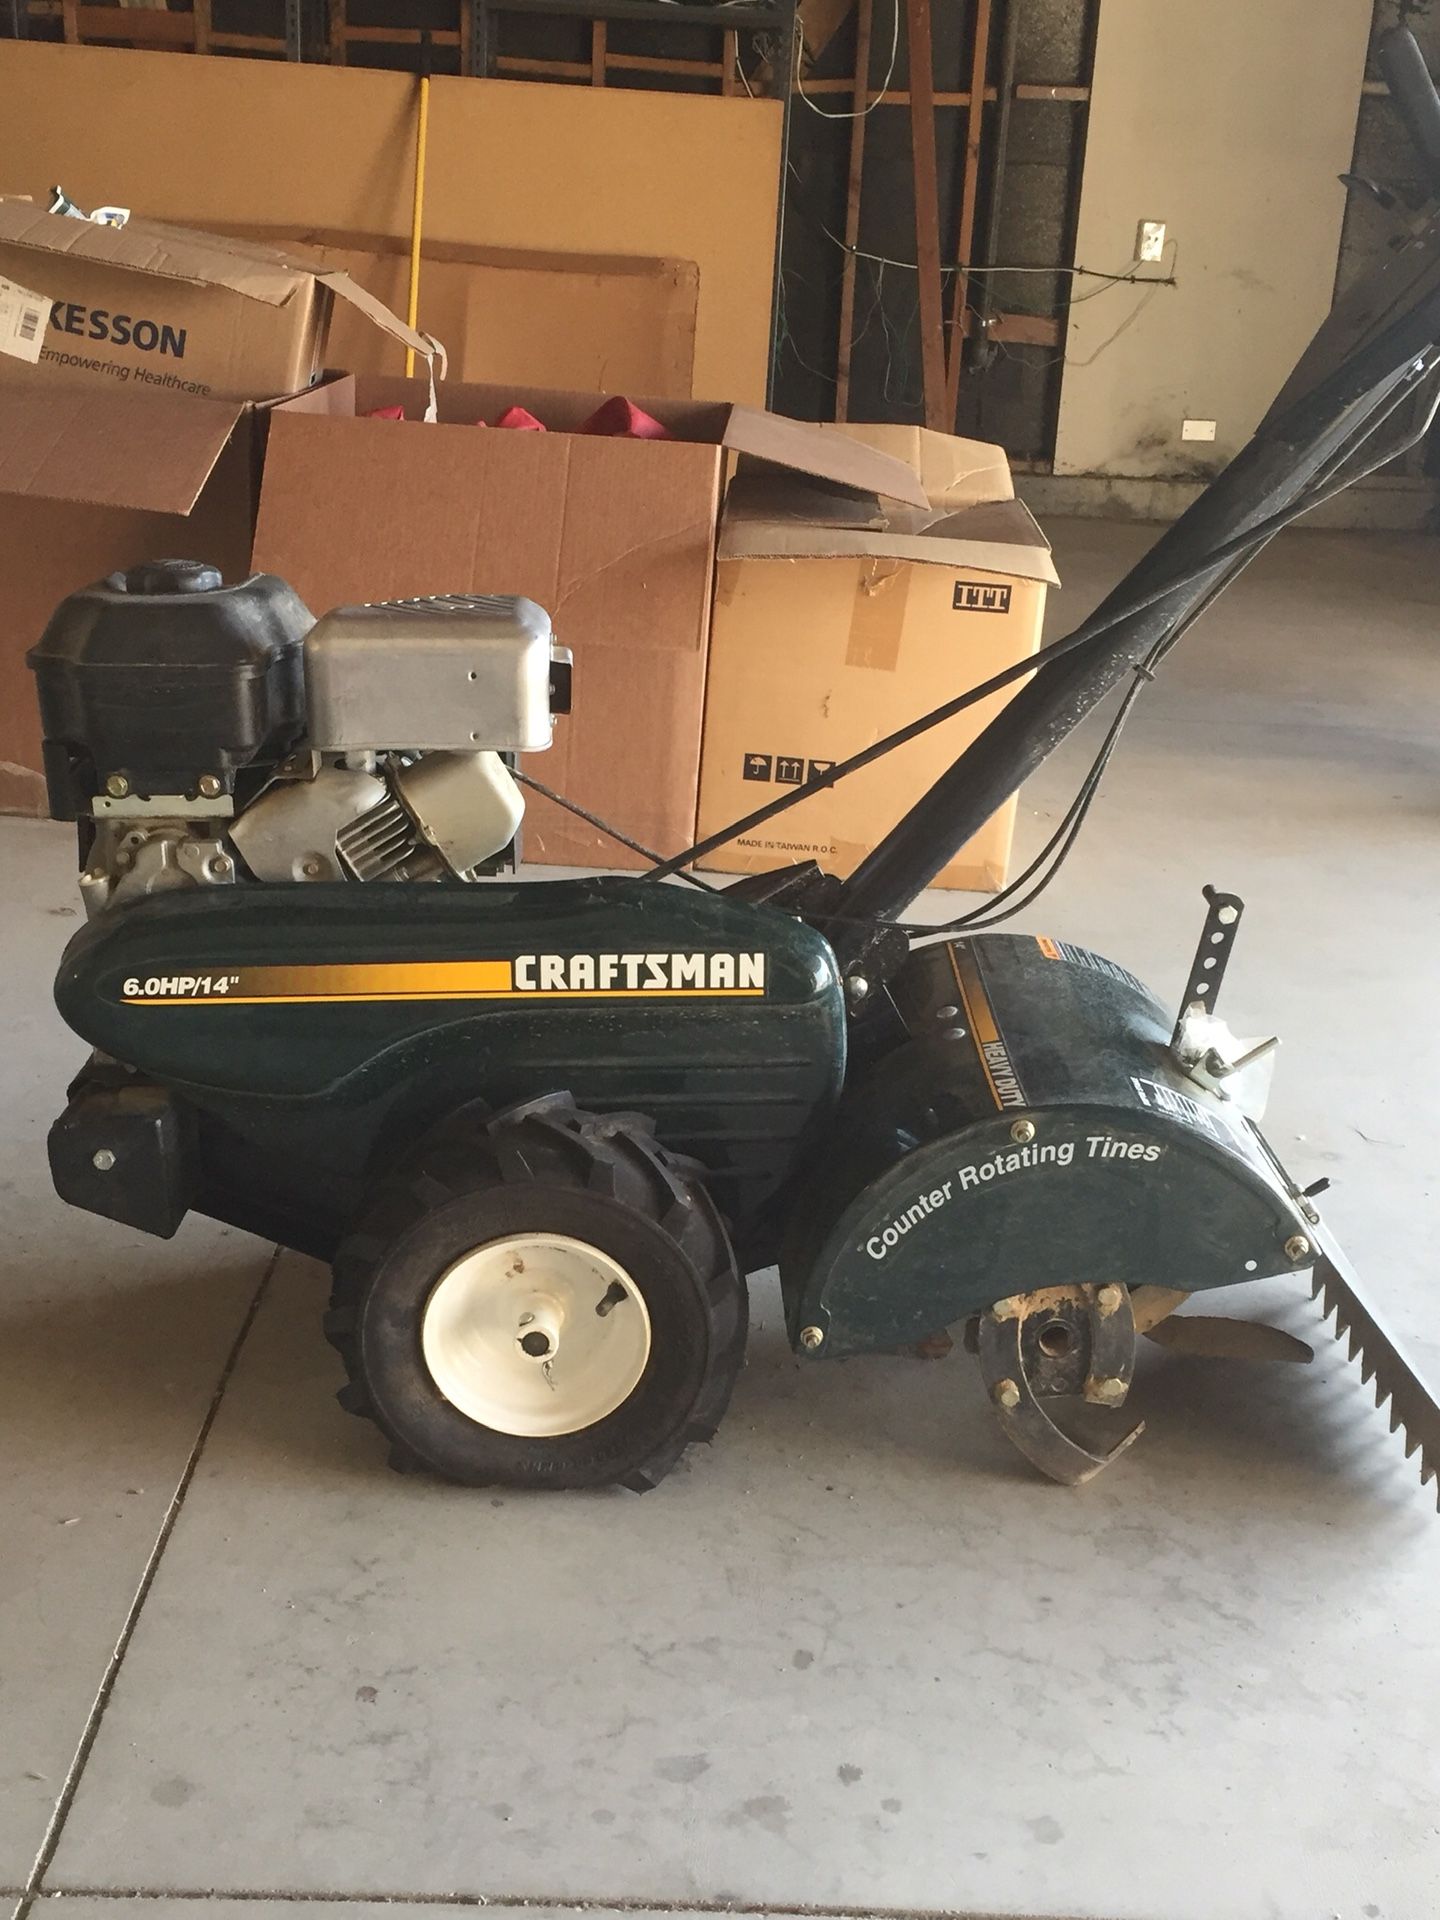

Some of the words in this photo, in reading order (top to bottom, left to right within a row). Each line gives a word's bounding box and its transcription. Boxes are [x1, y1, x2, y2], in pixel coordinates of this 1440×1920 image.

[40, 345, 130, 381] Empowering
[134, 367, 211, 396] Healthcare
[956, 585, 1008, 610] ITT
[737, 839, 762, 848] MADE
[764, 841, 774, 849] IN
[776, 842, 811, 852] TAIWAN
[123, 976, 239, 996] 6.0HP/14"
[515, 953, 764, 990] CRAFTSMAN
[982, 1041, 1014, 1077] HEAVY
[994, 1076, 1027, 1108] DUTY
[866, 1181, 953, 1260] Counter
[958, 1142, 1074, 1190] Rotating
[1086, 1136, 1160, 1161] Tines
